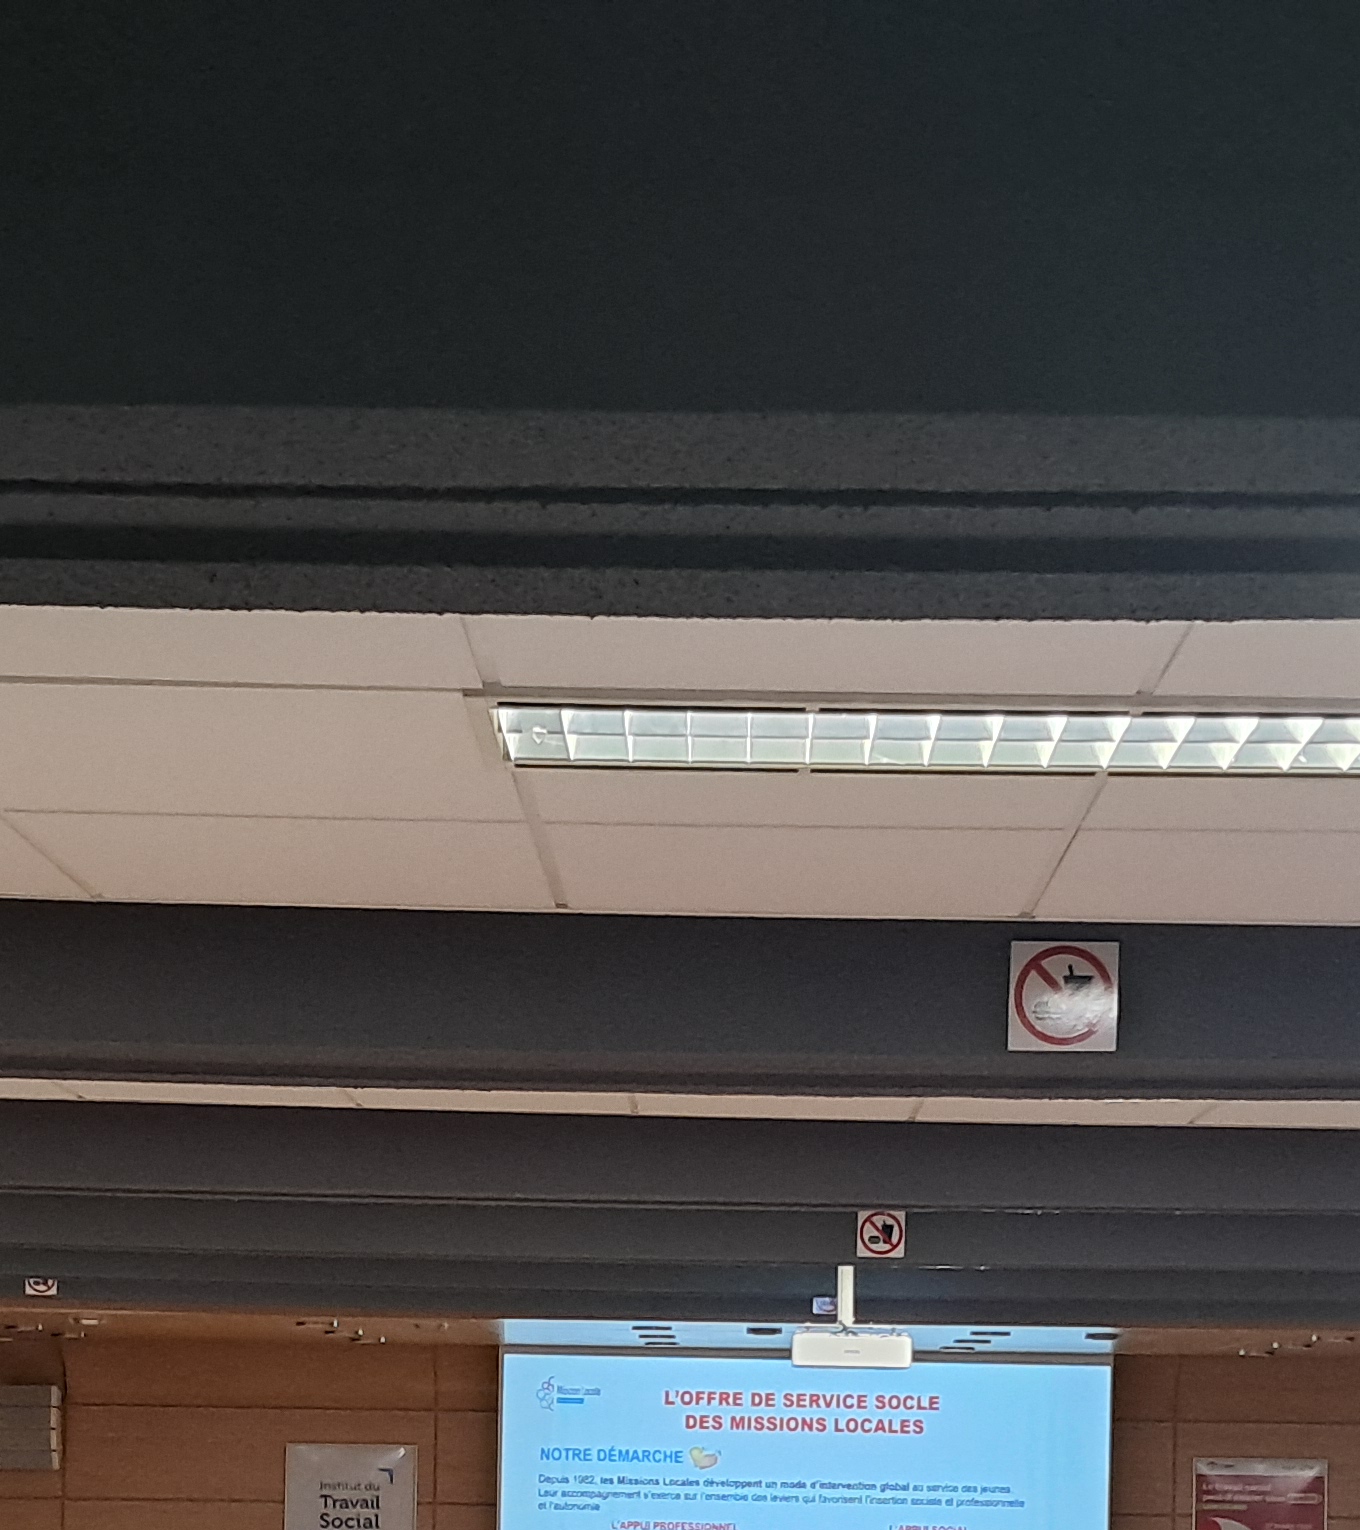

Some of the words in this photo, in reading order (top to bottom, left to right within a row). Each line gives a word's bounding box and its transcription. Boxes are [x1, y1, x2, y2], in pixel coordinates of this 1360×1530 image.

[664, 1390, 744, 1407] L'OFFRE
[750, 1392, 776, 1407] DE
[783, 1393, 868, 1410] SERVICE
[874, 1395, 940, 1411] SOCLE
[685, 1414, 723, 1430] DES
[730, 1415, 827, 1432] MISSIONS
[833, 1418, 925, 1434] LOCALES
[540, 1447, 593, 1462] NOTRE
[597, 1445, 684, 1464] DÉMARCHE
[320, 1481, 362, 1491] Institut
[364, 1481, 381, 1492] du
[538, 1474, 570, 1486] Depuis
[600, 1476, 615, 1486] les
[617, 1476, 660, 1487] Missions
[663, 1477, 700, 1488] Locales
[703, 1478, 763, 1490] développent
[765, 1480, 778, 1490] un
[780, 1479, 807, 1490] mode
[810, 1480, 877, 1491] d'intervention
[879, 1482, 910, 1494] global
[912, 1484, 924, 1493] au
[926, 1483, 959, 1494] service
[961, 1483, 978, 1494] des
[319, 1494, 381, 1510] Travail
[538, 1488, 558, 1498] Leur
[561, 1489, 642, 1501] accompagnement
[684, 1491, 698, 1501] sur
[700, 1491, 749, 1502] l'ensemble
[751, 1493, 768, 1503] des
[770, 1492, 800, 1503] leviers
[802, 1493, 817, 1505] qui
[818, 1493, 863, 1504] favorisent
[865, 1494, 908, 1505] l'insertion
[945, 1496, 954, 1507] et
[956, 1497, 1026, 1509] professionnelle
[538, 1502, 547, 1511] et
[319, 1512, 381, 1530] Social
[611, 1520, 650, 1530] L'APPUI
